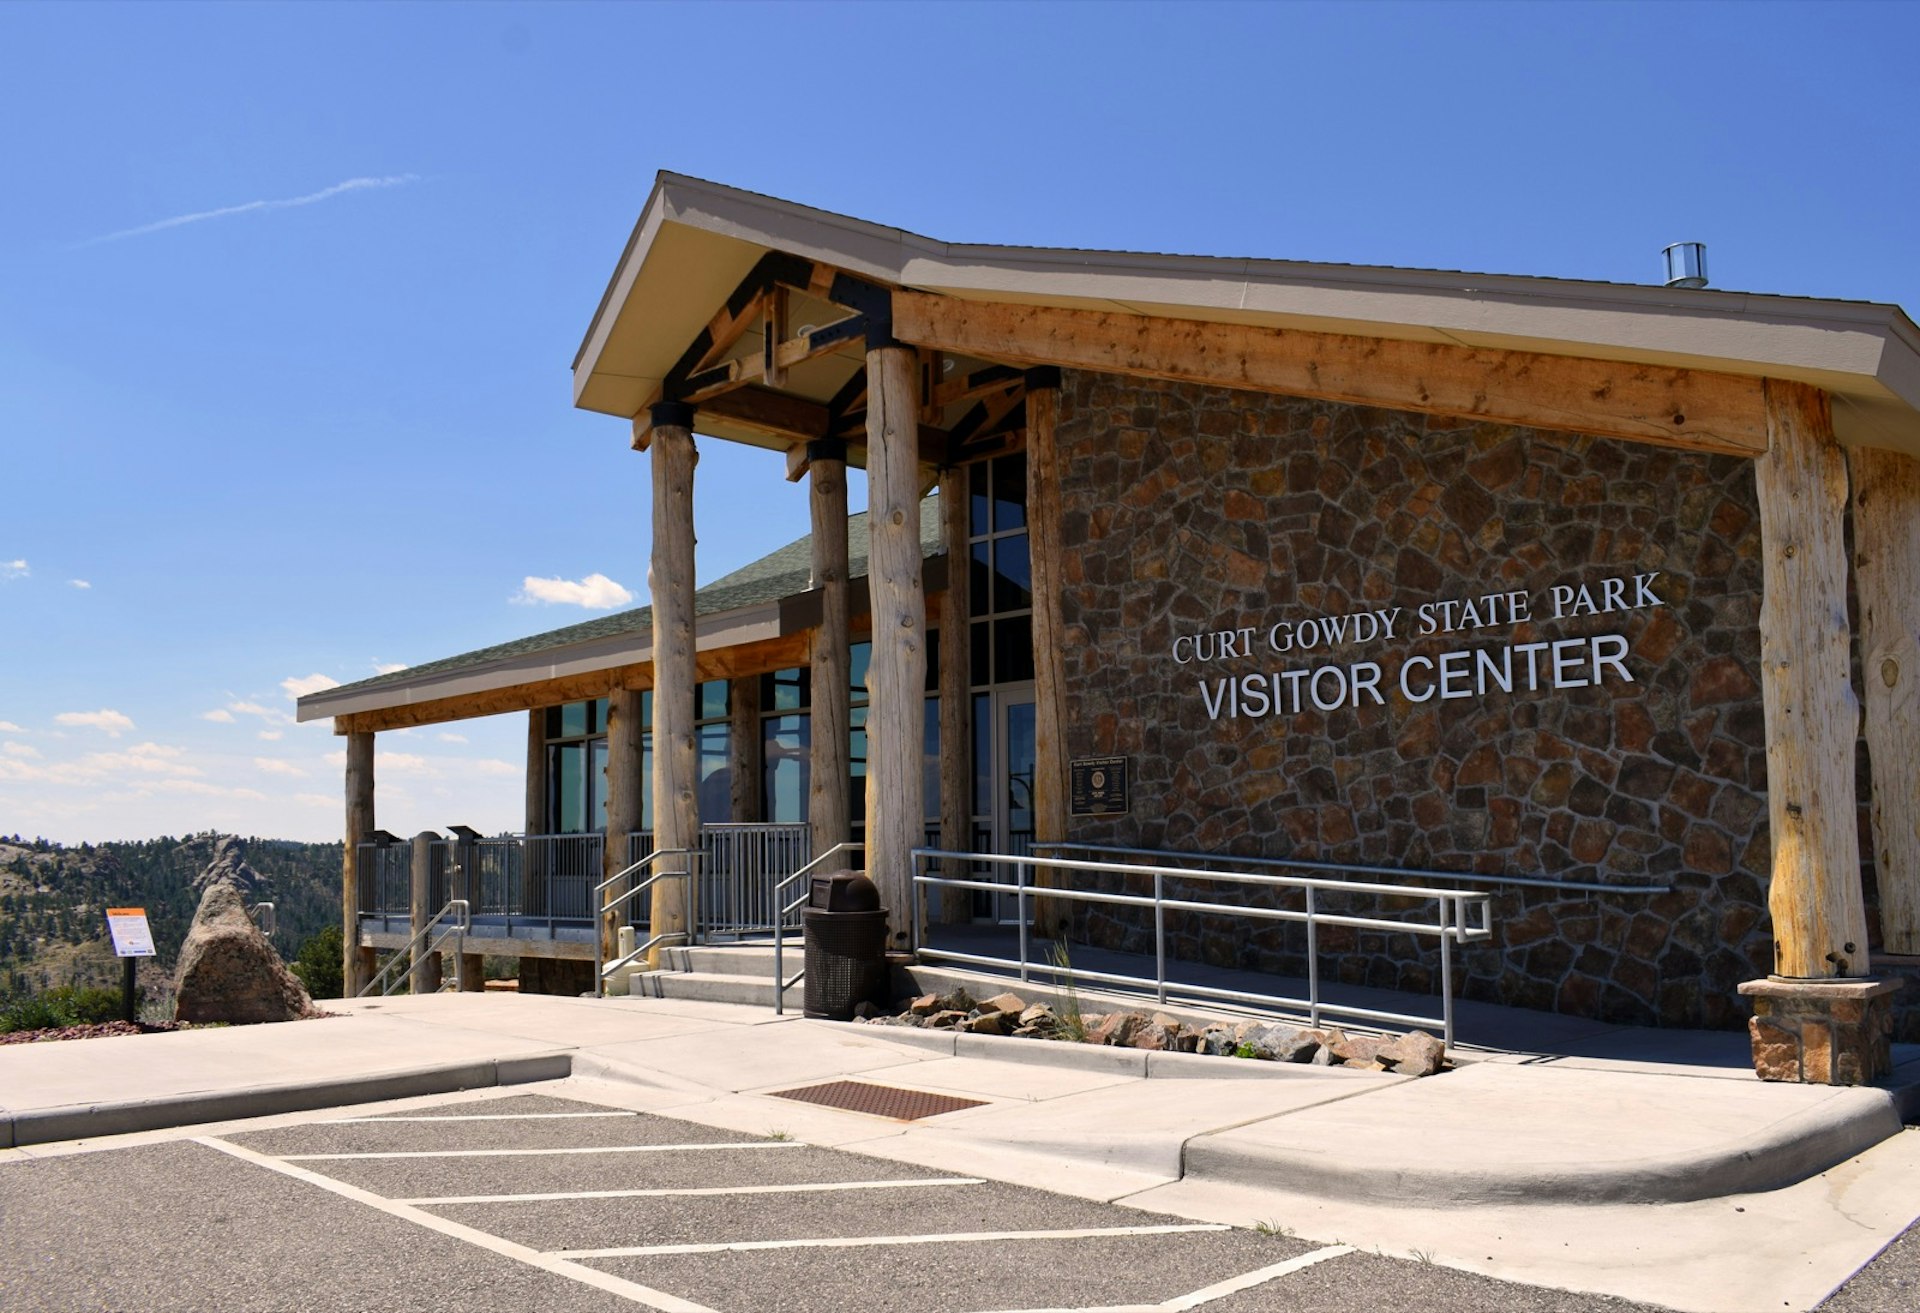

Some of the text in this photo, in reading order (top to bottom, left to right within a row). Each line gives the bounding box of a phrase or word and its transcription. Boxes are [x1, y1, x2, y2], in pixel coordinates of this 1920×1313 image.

[1172, 572, 1665, 664] CURT GOWDY STATE PARK
[1199, 634, 1634, 720] VISITOR CENTER
